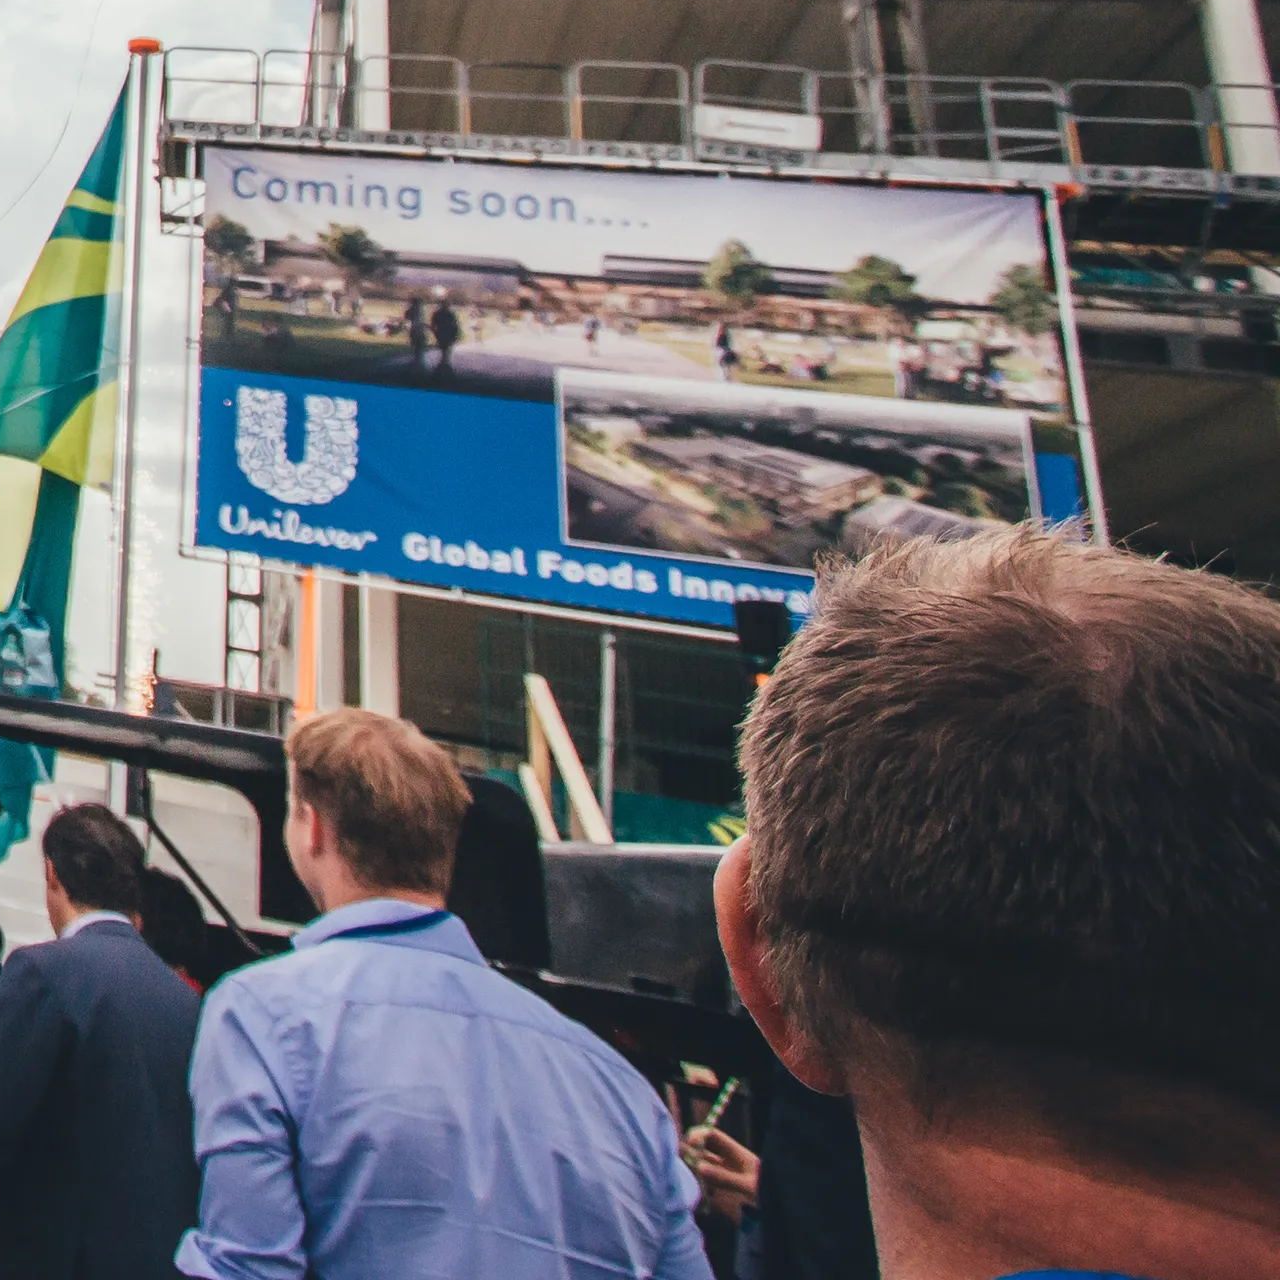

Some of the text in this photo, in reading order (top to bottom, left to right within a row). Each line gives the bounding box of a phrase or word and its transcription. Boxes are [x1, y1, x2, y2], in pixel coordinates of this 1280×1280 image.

[231, 165, 422, 219] Coming
[218, 503, 378, 552] Unilever
[402, 531, 815, 615] Global Foods Innova
